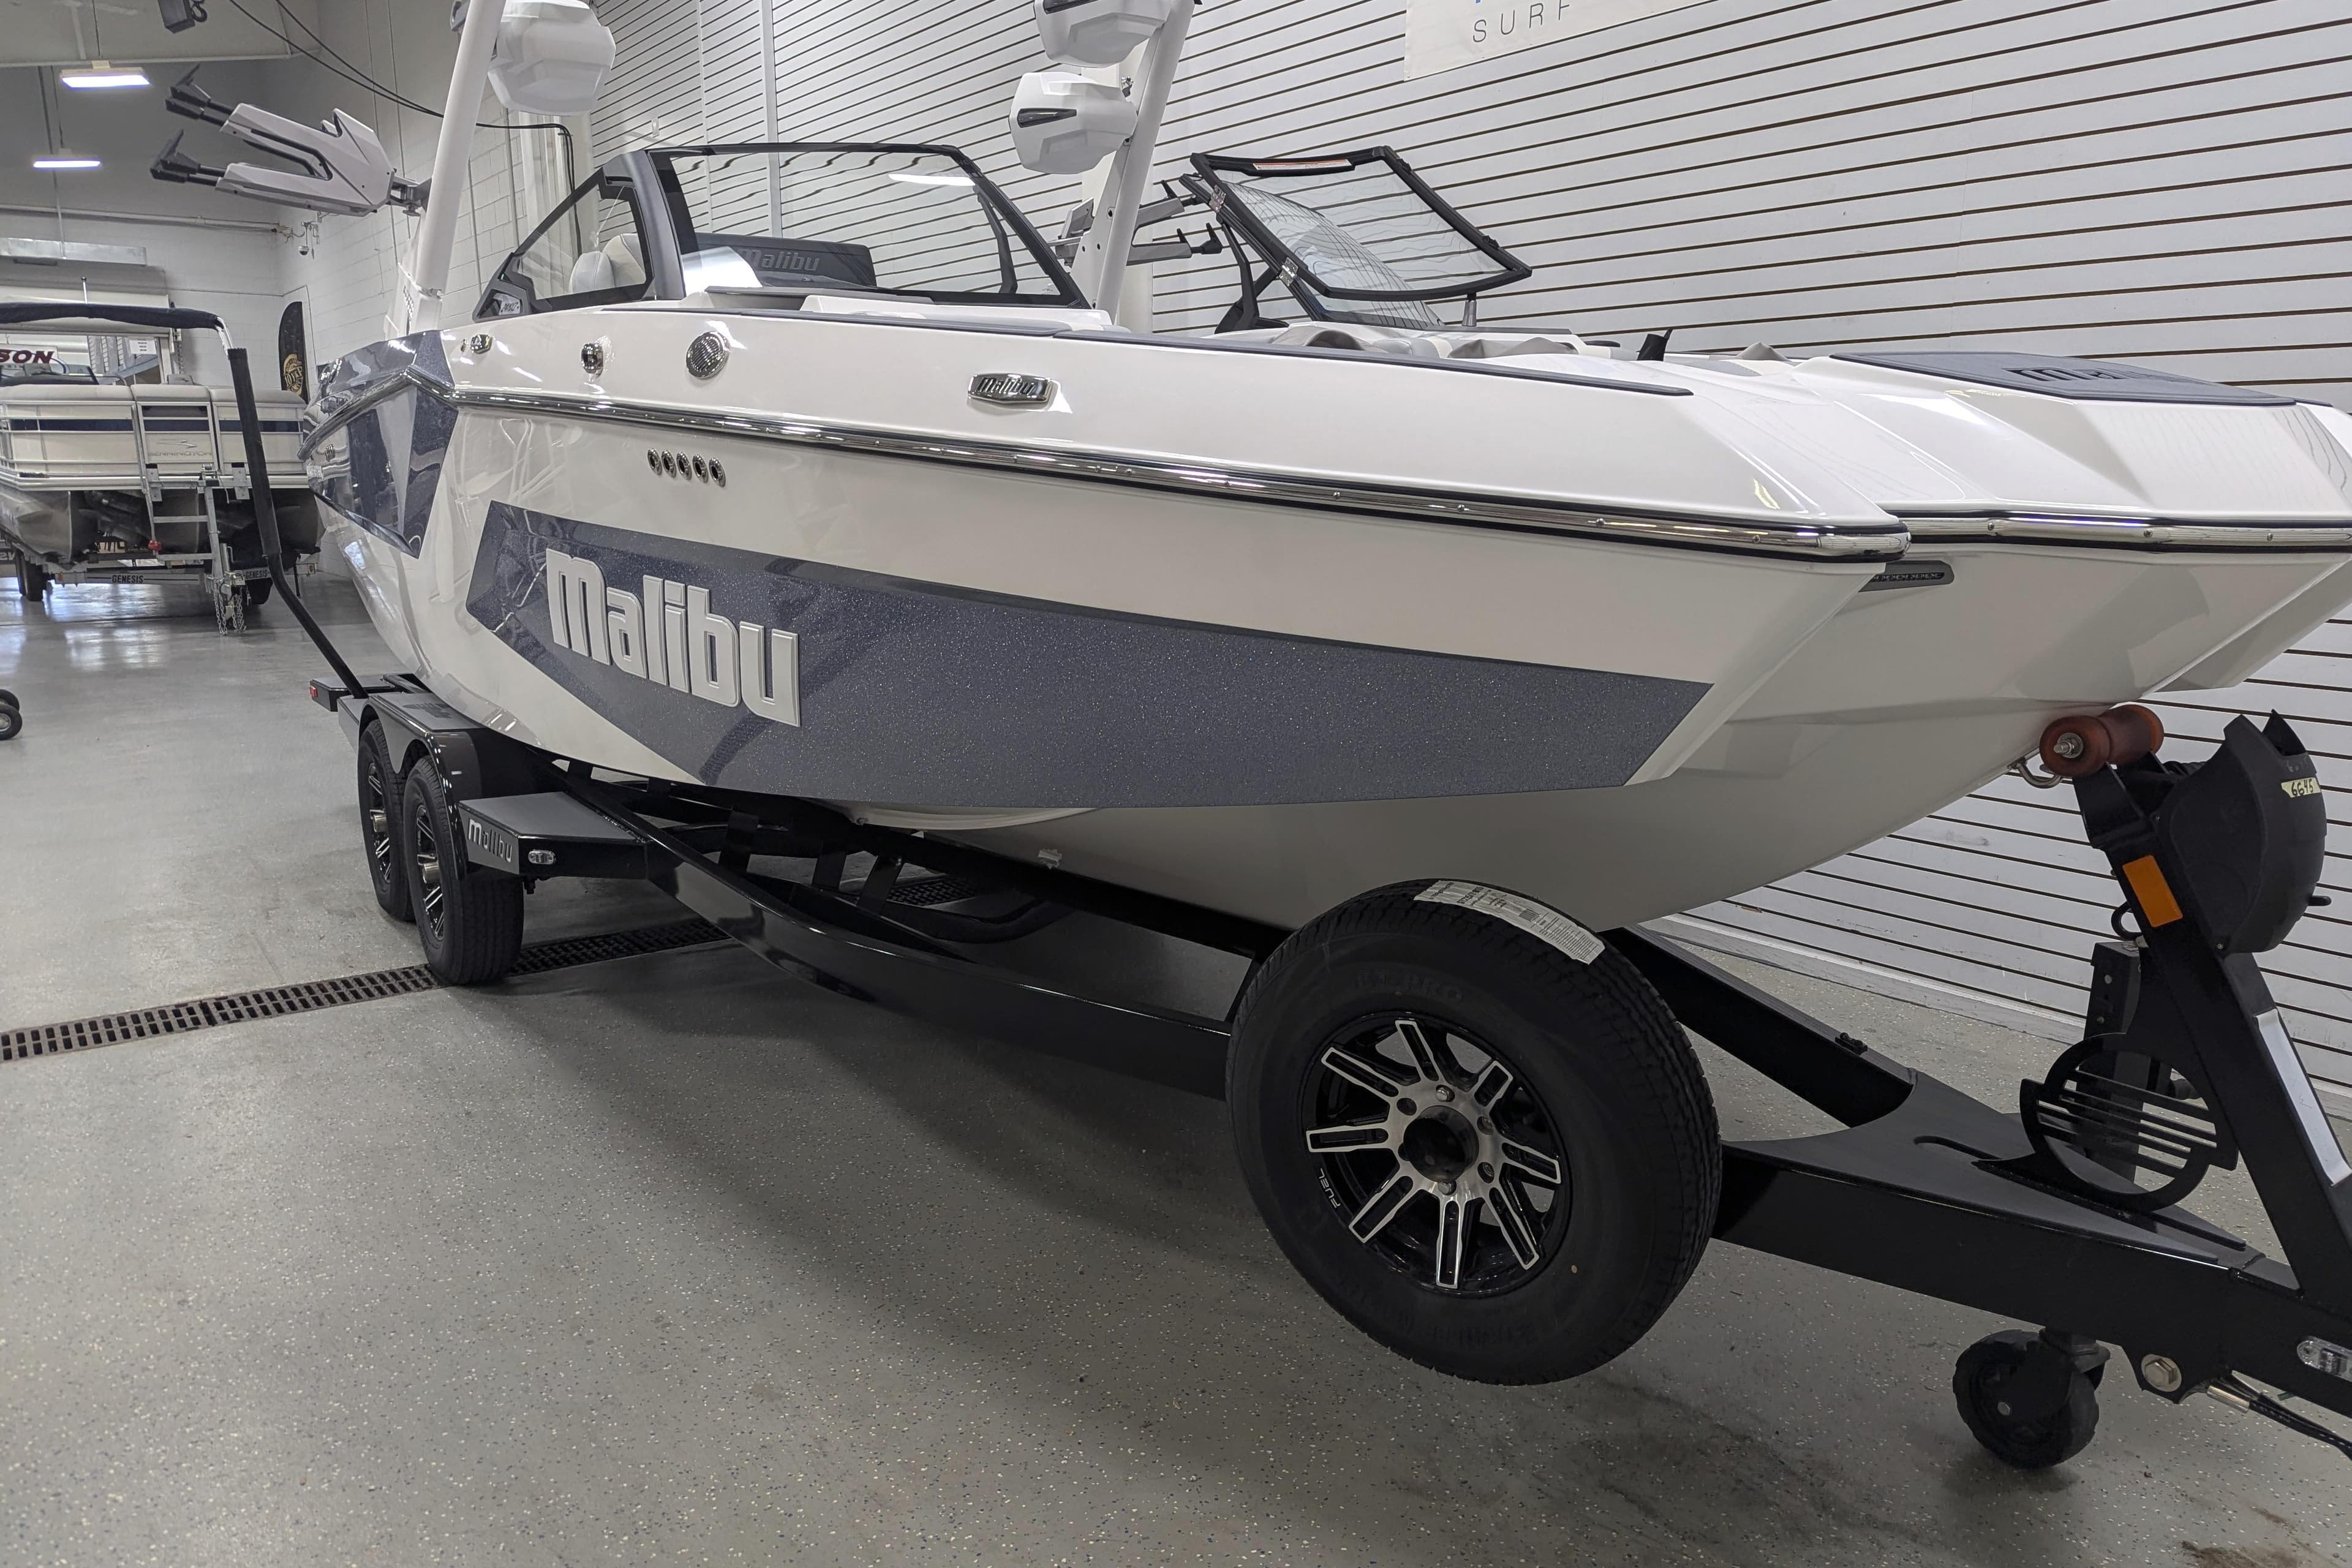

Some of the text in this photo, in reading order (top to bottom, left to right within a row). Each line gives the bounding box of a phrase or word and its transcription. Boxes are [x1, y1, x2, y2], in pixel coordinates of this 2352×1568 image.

[1472, 0, 1570, 42] SURF
[737, 249, 820, 271] Malibu
[976, 377, 1035, 396] Malibu
[112, 575, 144, 583] GENESIS
[245, 569, 268, 579] GENESIS
[546, 548, 801, 727] Malibu
[2291, 778, 2314, 797] 6645
[1319, 1167, 1341, 1208] FUEL
